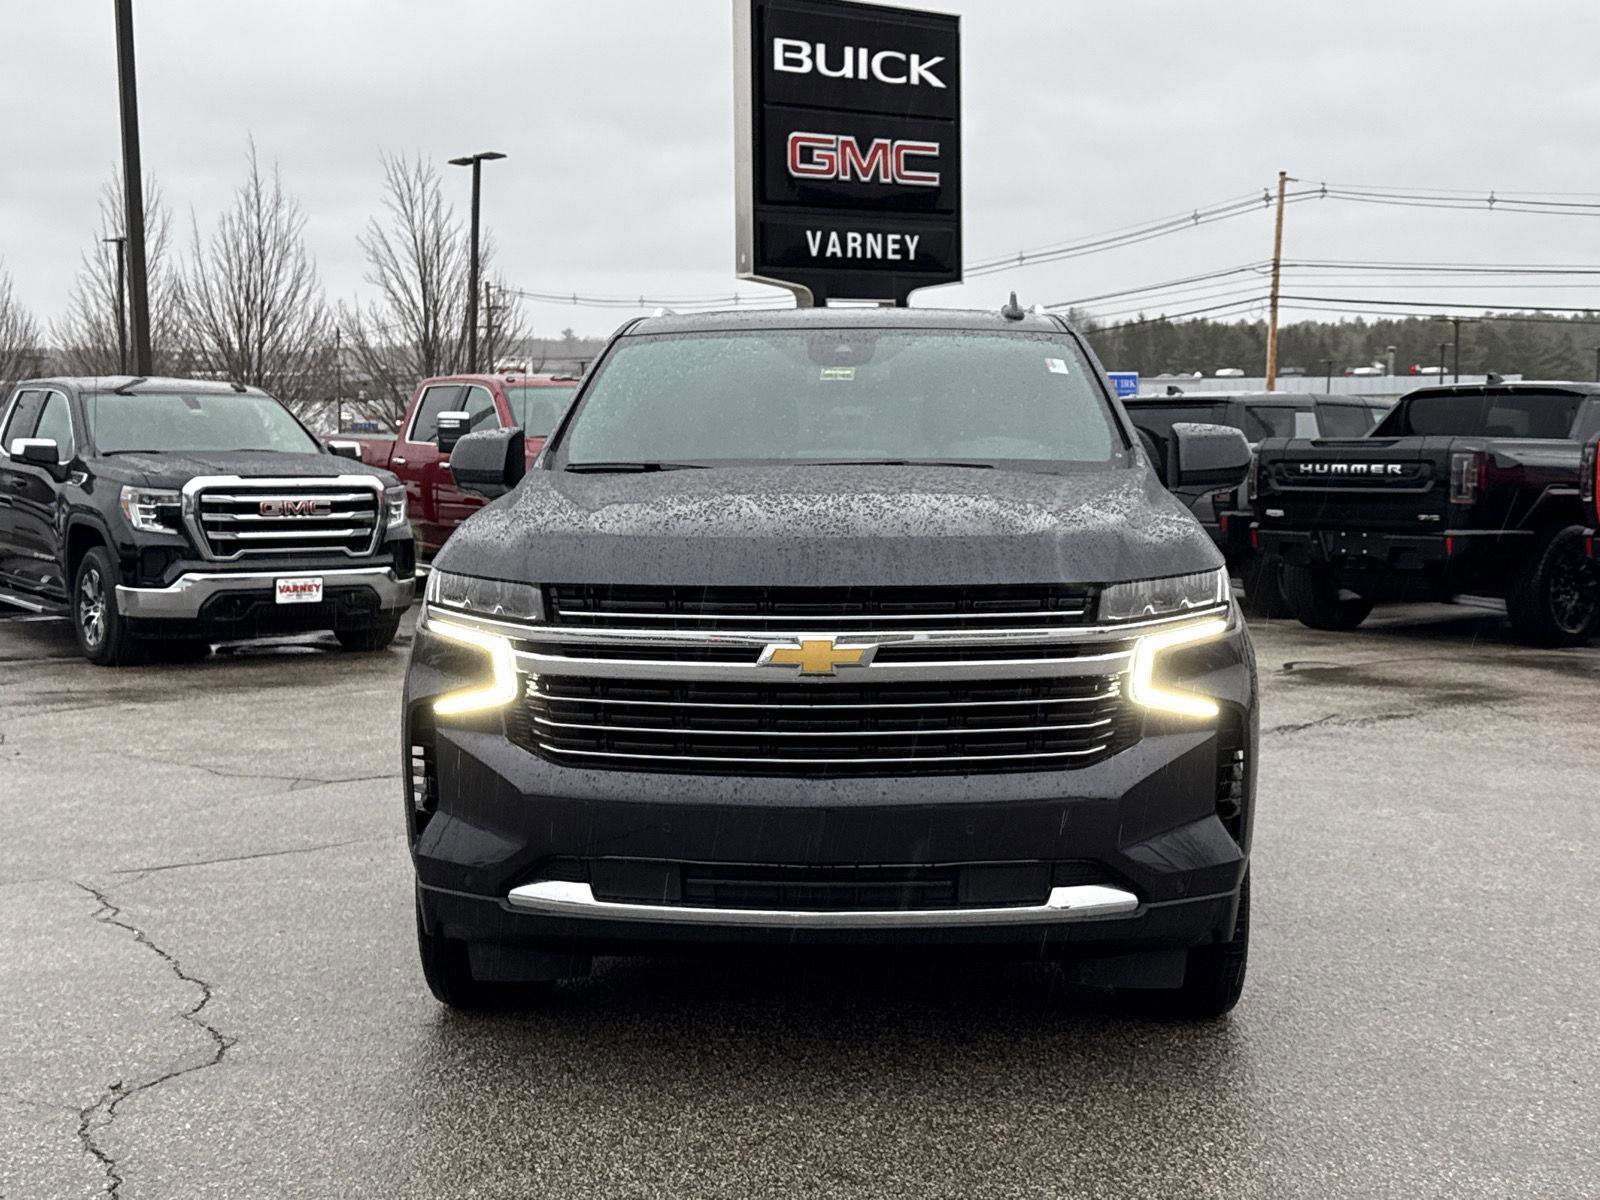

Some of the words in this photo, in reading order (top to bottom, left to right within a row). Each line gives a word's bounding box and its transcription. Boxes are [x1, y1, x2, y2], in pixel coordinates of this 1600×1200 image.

[773, 37, 947, 89] BUICK
[787, 131, 940, 186] GMC
[805, 229, 920, 261] VARNEY
[1300, 463, 1402, 475] HUMMER
[259, 500, 332, 516] GMC
[278, 583, 321, 594] VARNEY
